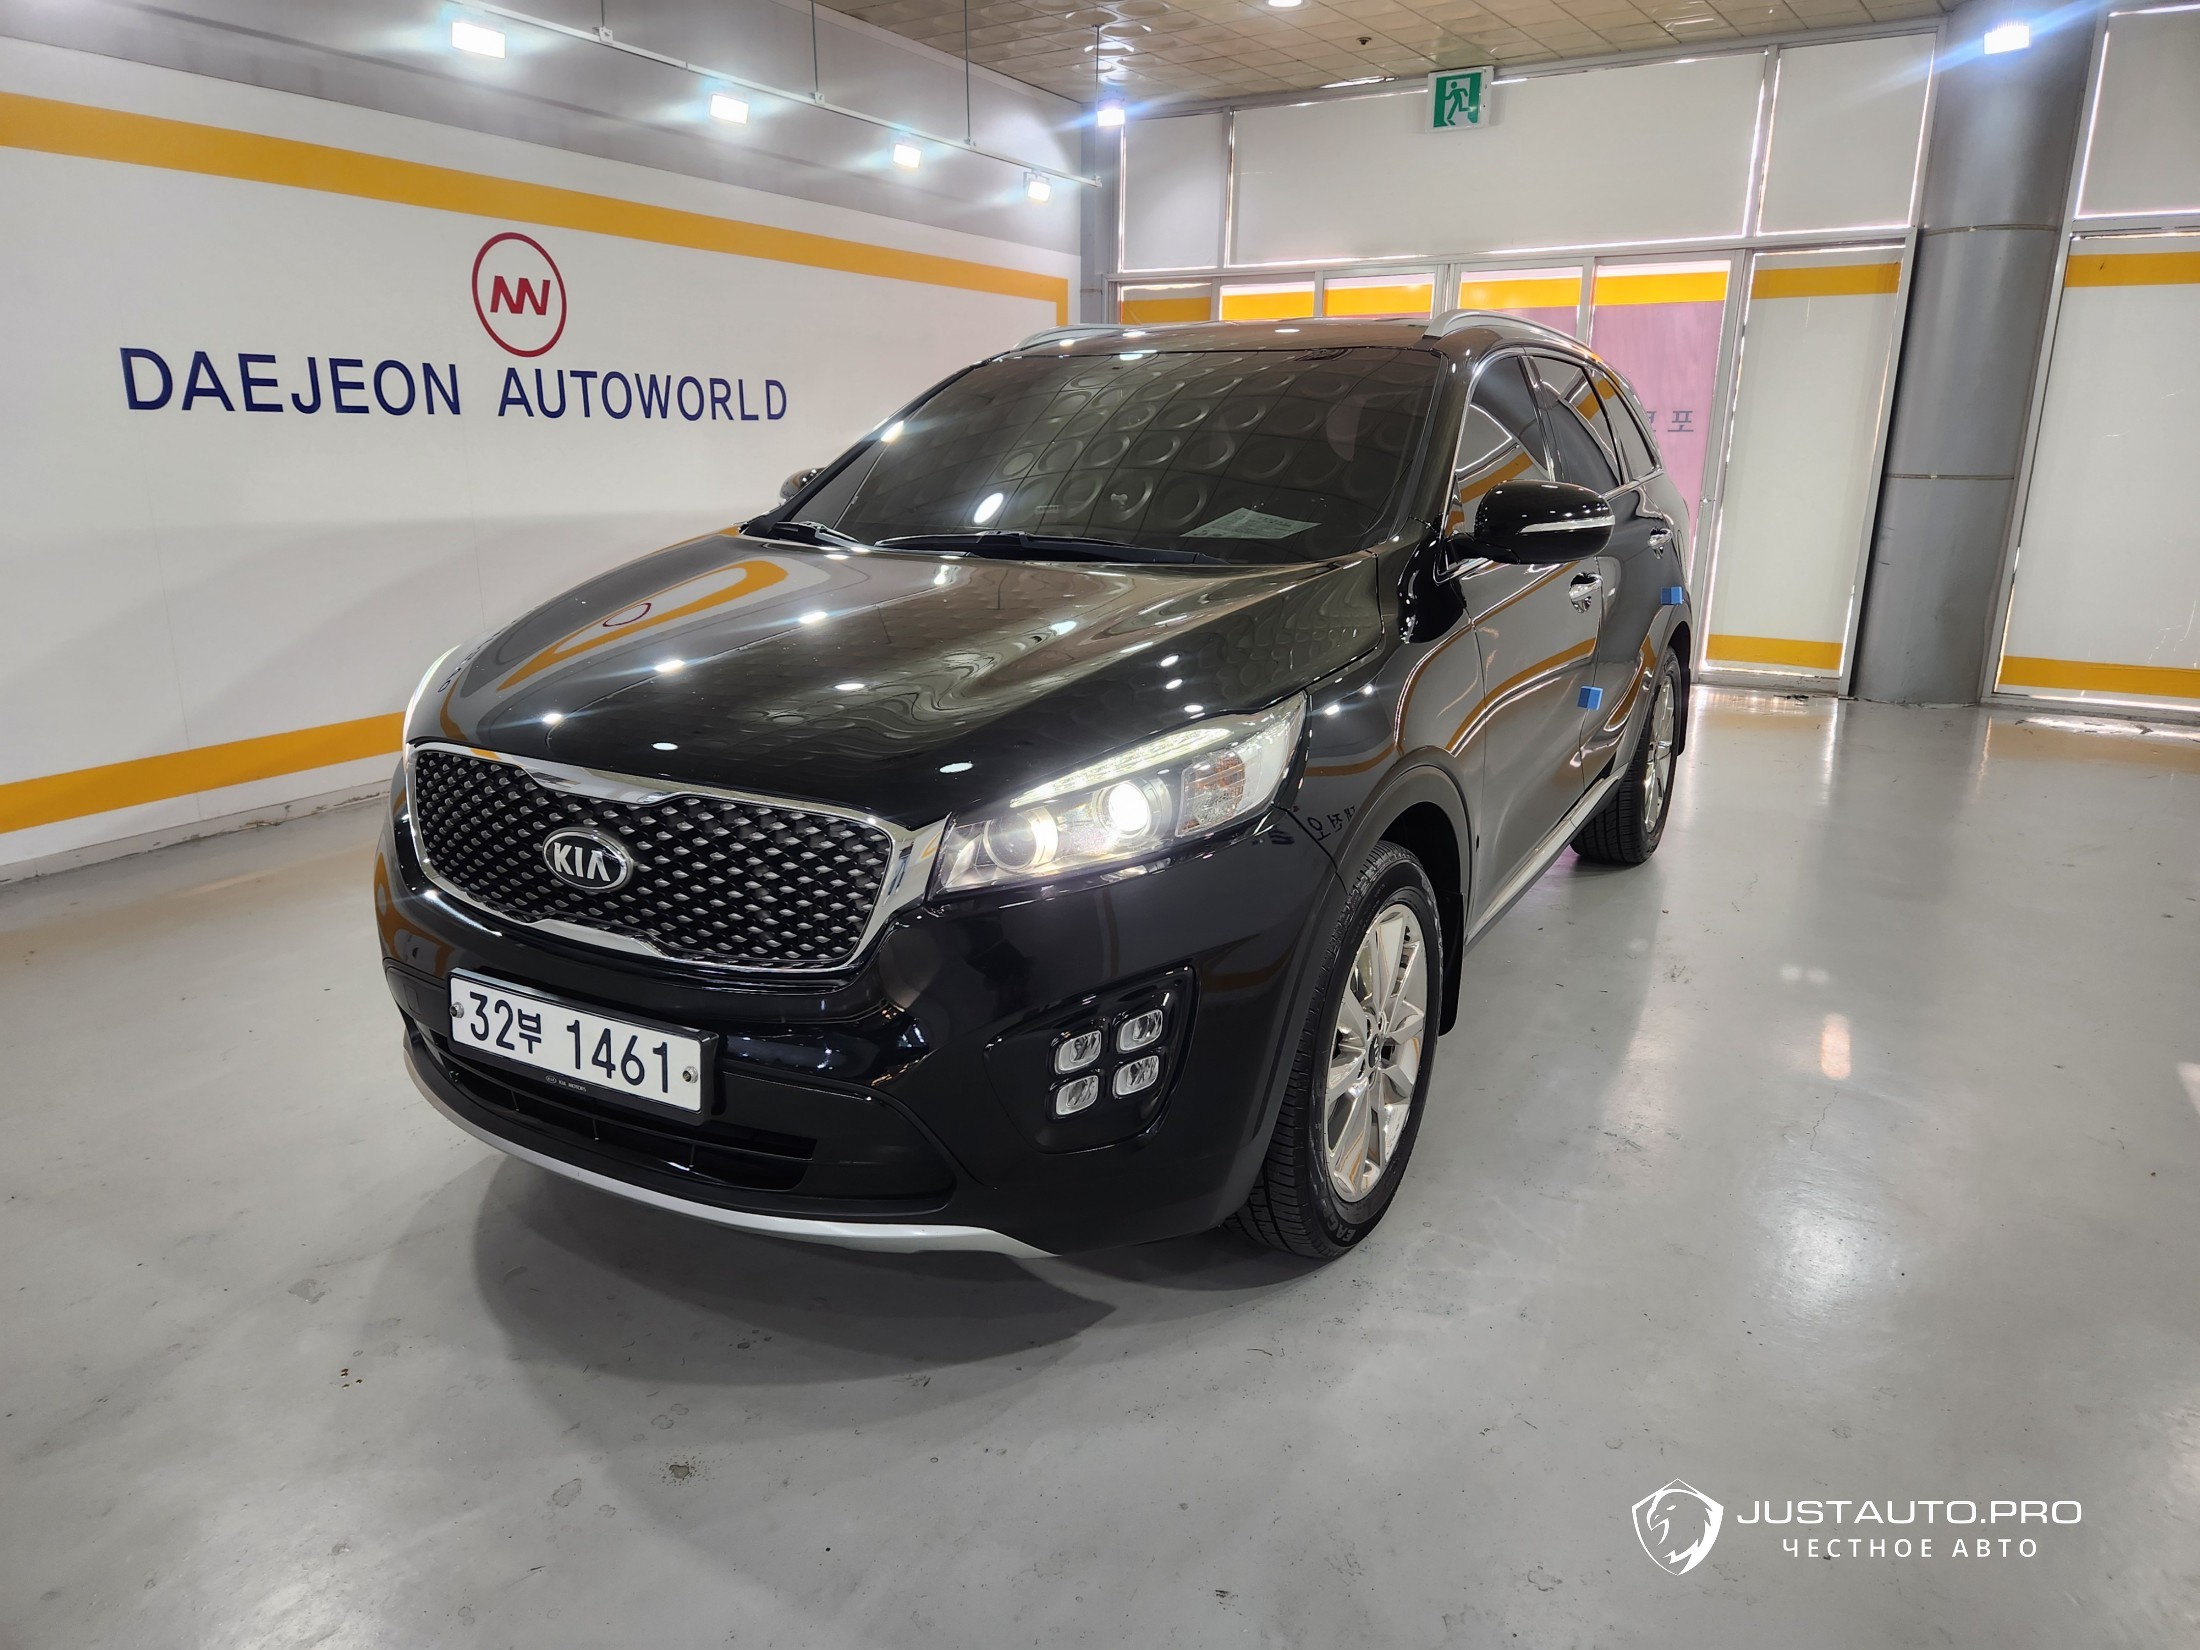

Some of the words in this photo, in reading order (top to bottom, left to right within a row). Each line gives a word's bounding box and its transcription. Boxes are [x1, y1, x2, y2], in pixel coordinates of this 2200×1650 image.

[119, 347, 461, 416] DAEJEON
[498, 367, 788, 422] AUTOWORLD
[554, 842, 611, 882] KIA
[469, 991, 542, 1054] 32부
[566, 1019, 669, 1094] 1461
[568, 1082, 587, 1092] MOTORS
